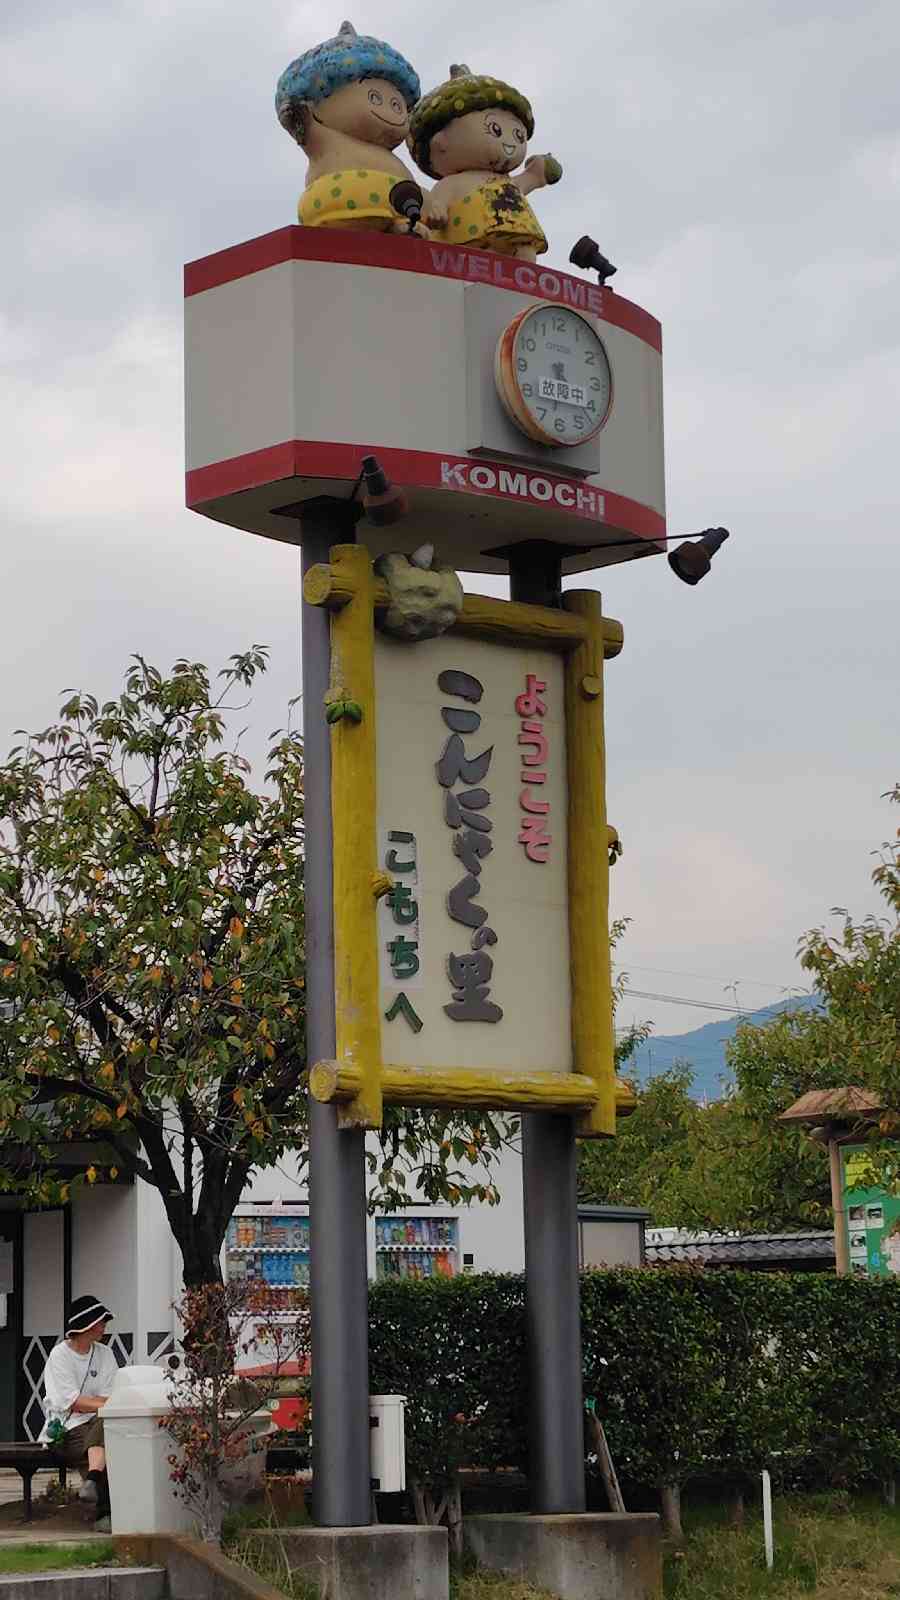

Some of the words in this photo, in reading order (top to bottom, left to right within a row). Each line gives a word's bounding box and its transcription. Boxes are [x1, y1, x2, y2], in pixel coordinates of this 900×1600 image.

[430, 248, 604, 314] WELCOME
[533, 320, 546, 337] 11
[551, 316, 567, 333] 12
[520, 336, 536, 352] 10
[517, 357, 527, 372] 9
[583, 350, 595, 366] 2
[522, 383, 533, 397] 8
[542, 380, 584, 403] 故障中
[589, 376, 601, 391] 3
[536, 406, 547, 421] 7
[553, 418, 565, 432] 6
[573, 415, 585, 430] 5
[440, 461, 606, 516] KOMOCHI
[515, 674, 552, 863] ようこそ
[385, 831, 423, 1034] こもちへ
